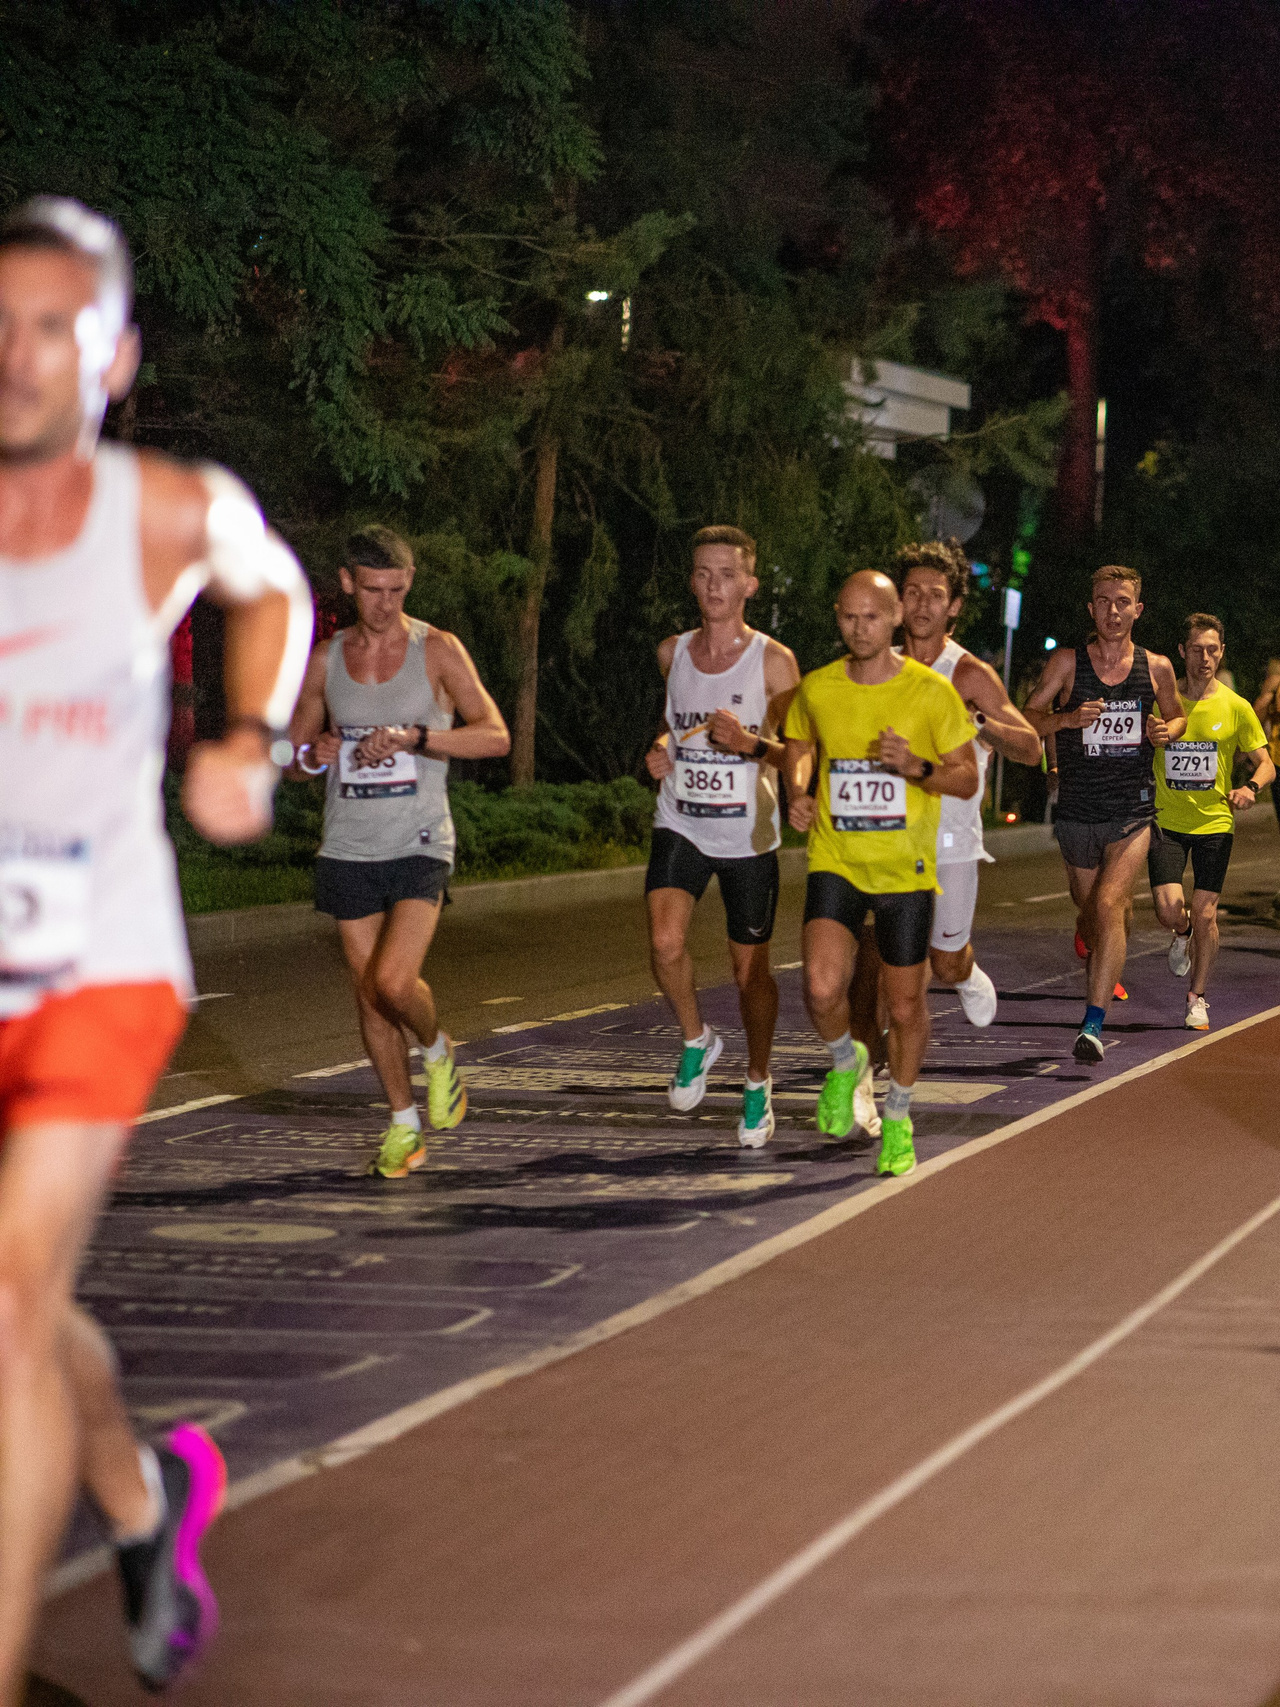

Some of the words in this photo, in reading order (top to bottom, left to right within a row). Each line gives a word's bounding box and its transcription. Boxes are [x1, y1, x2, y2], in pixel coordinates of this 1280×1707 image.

[1092, 716, 1134, 734] 7969
[1171, 756, 1210, 771] 2791
[684, 768, 734, 791] 3861
[838, 781, 895, 802] 4170
